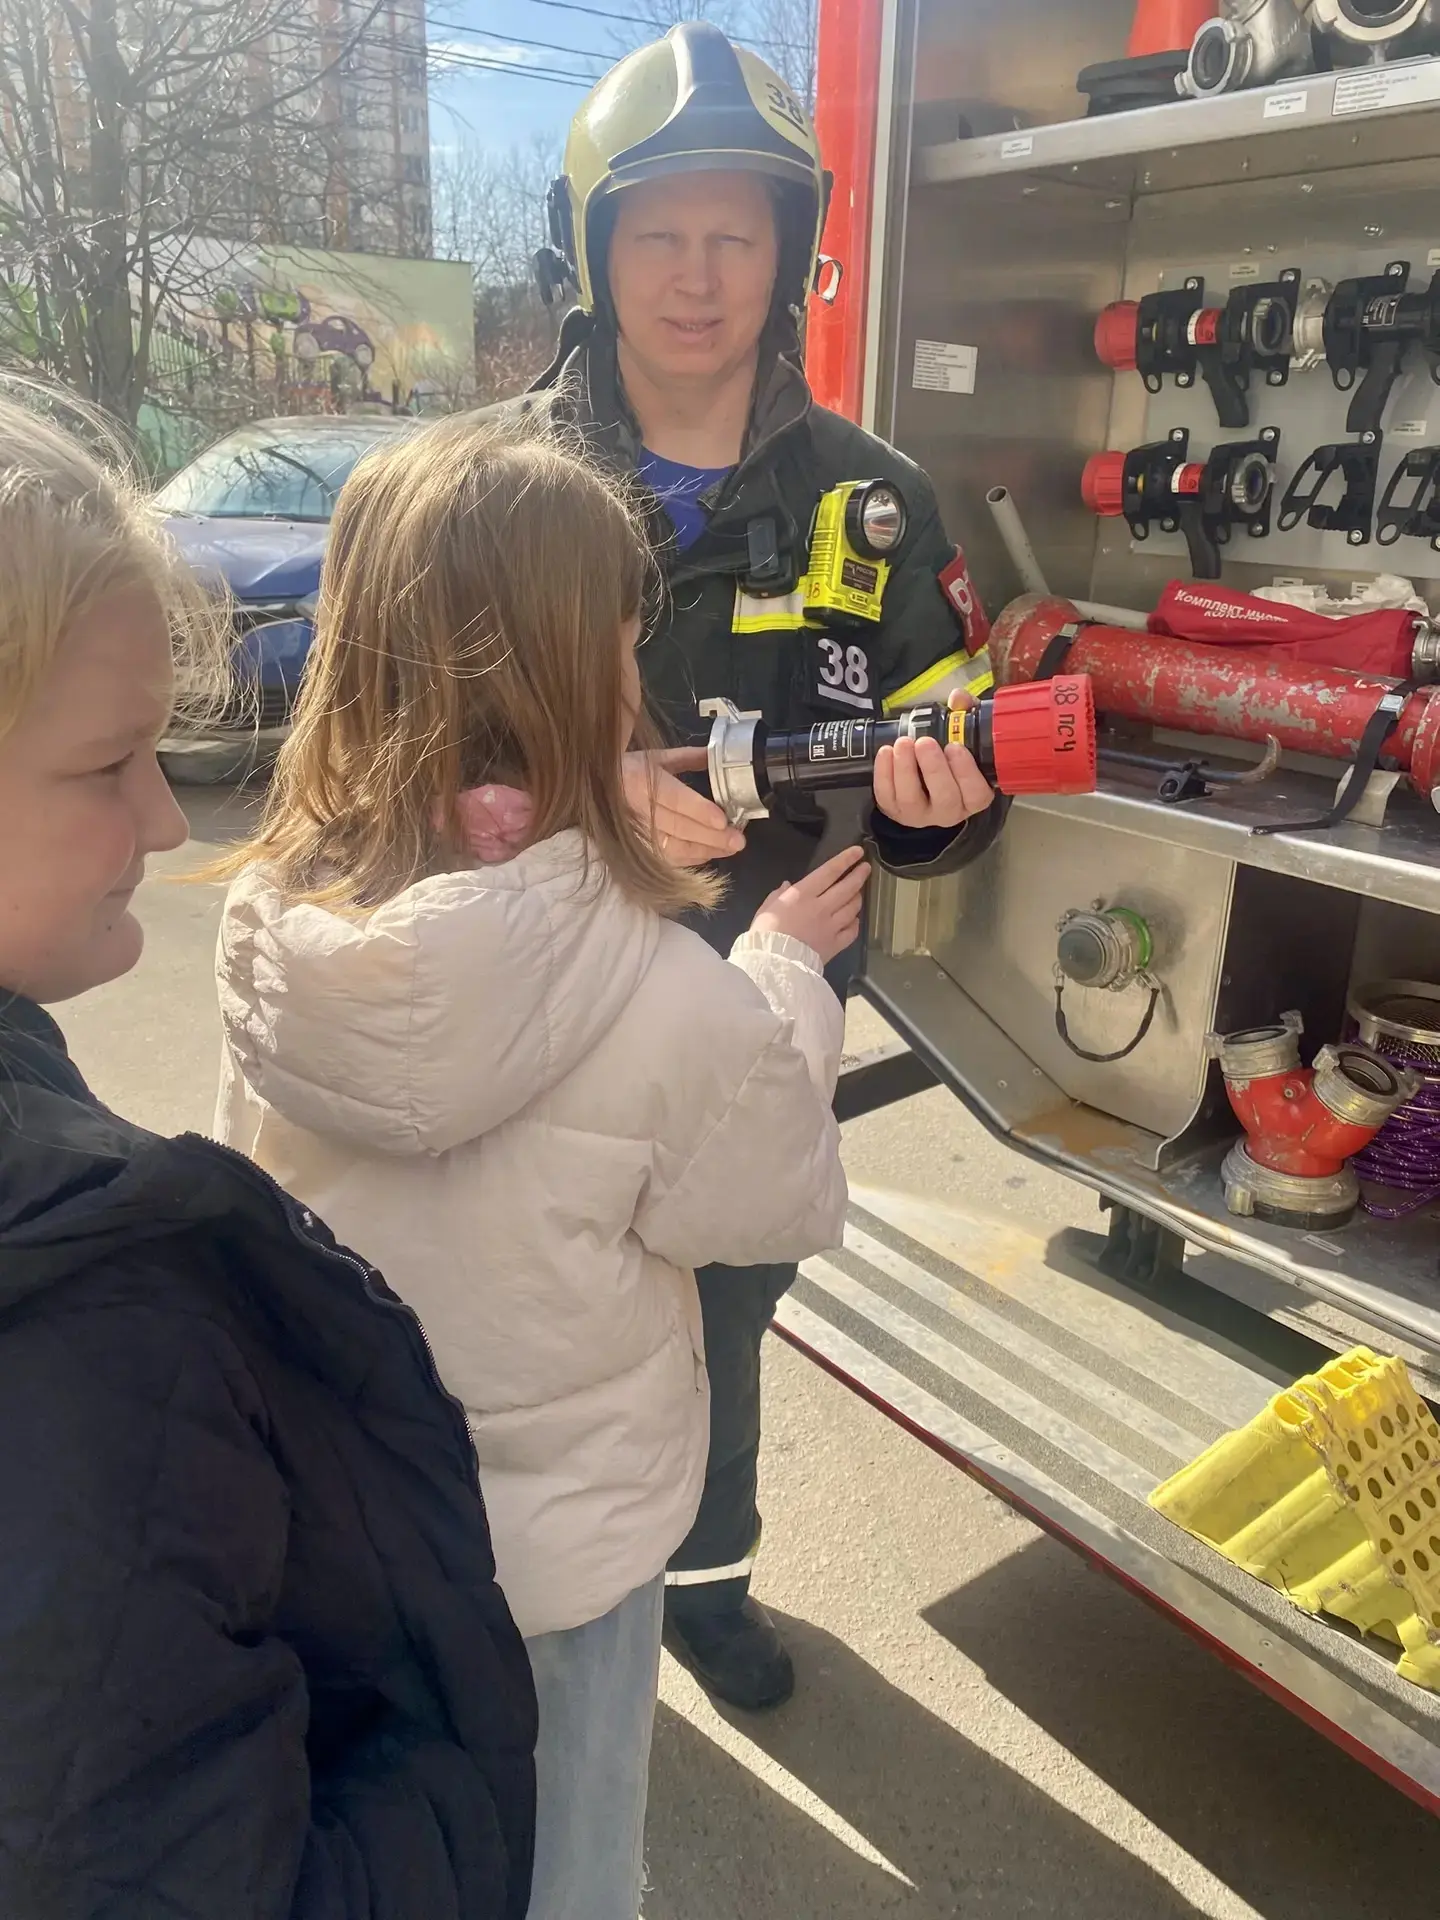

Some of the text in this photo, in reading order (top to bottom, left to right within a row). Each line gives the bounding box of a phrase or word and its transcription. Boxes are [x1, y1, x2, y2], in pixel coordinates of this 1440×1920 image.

[766, 82, 804, 125] 38
[1174, 589, 1245, 615] Комплект
[817, 638, 869, 694] 38
[1055, 682, 1080, 706] 38
